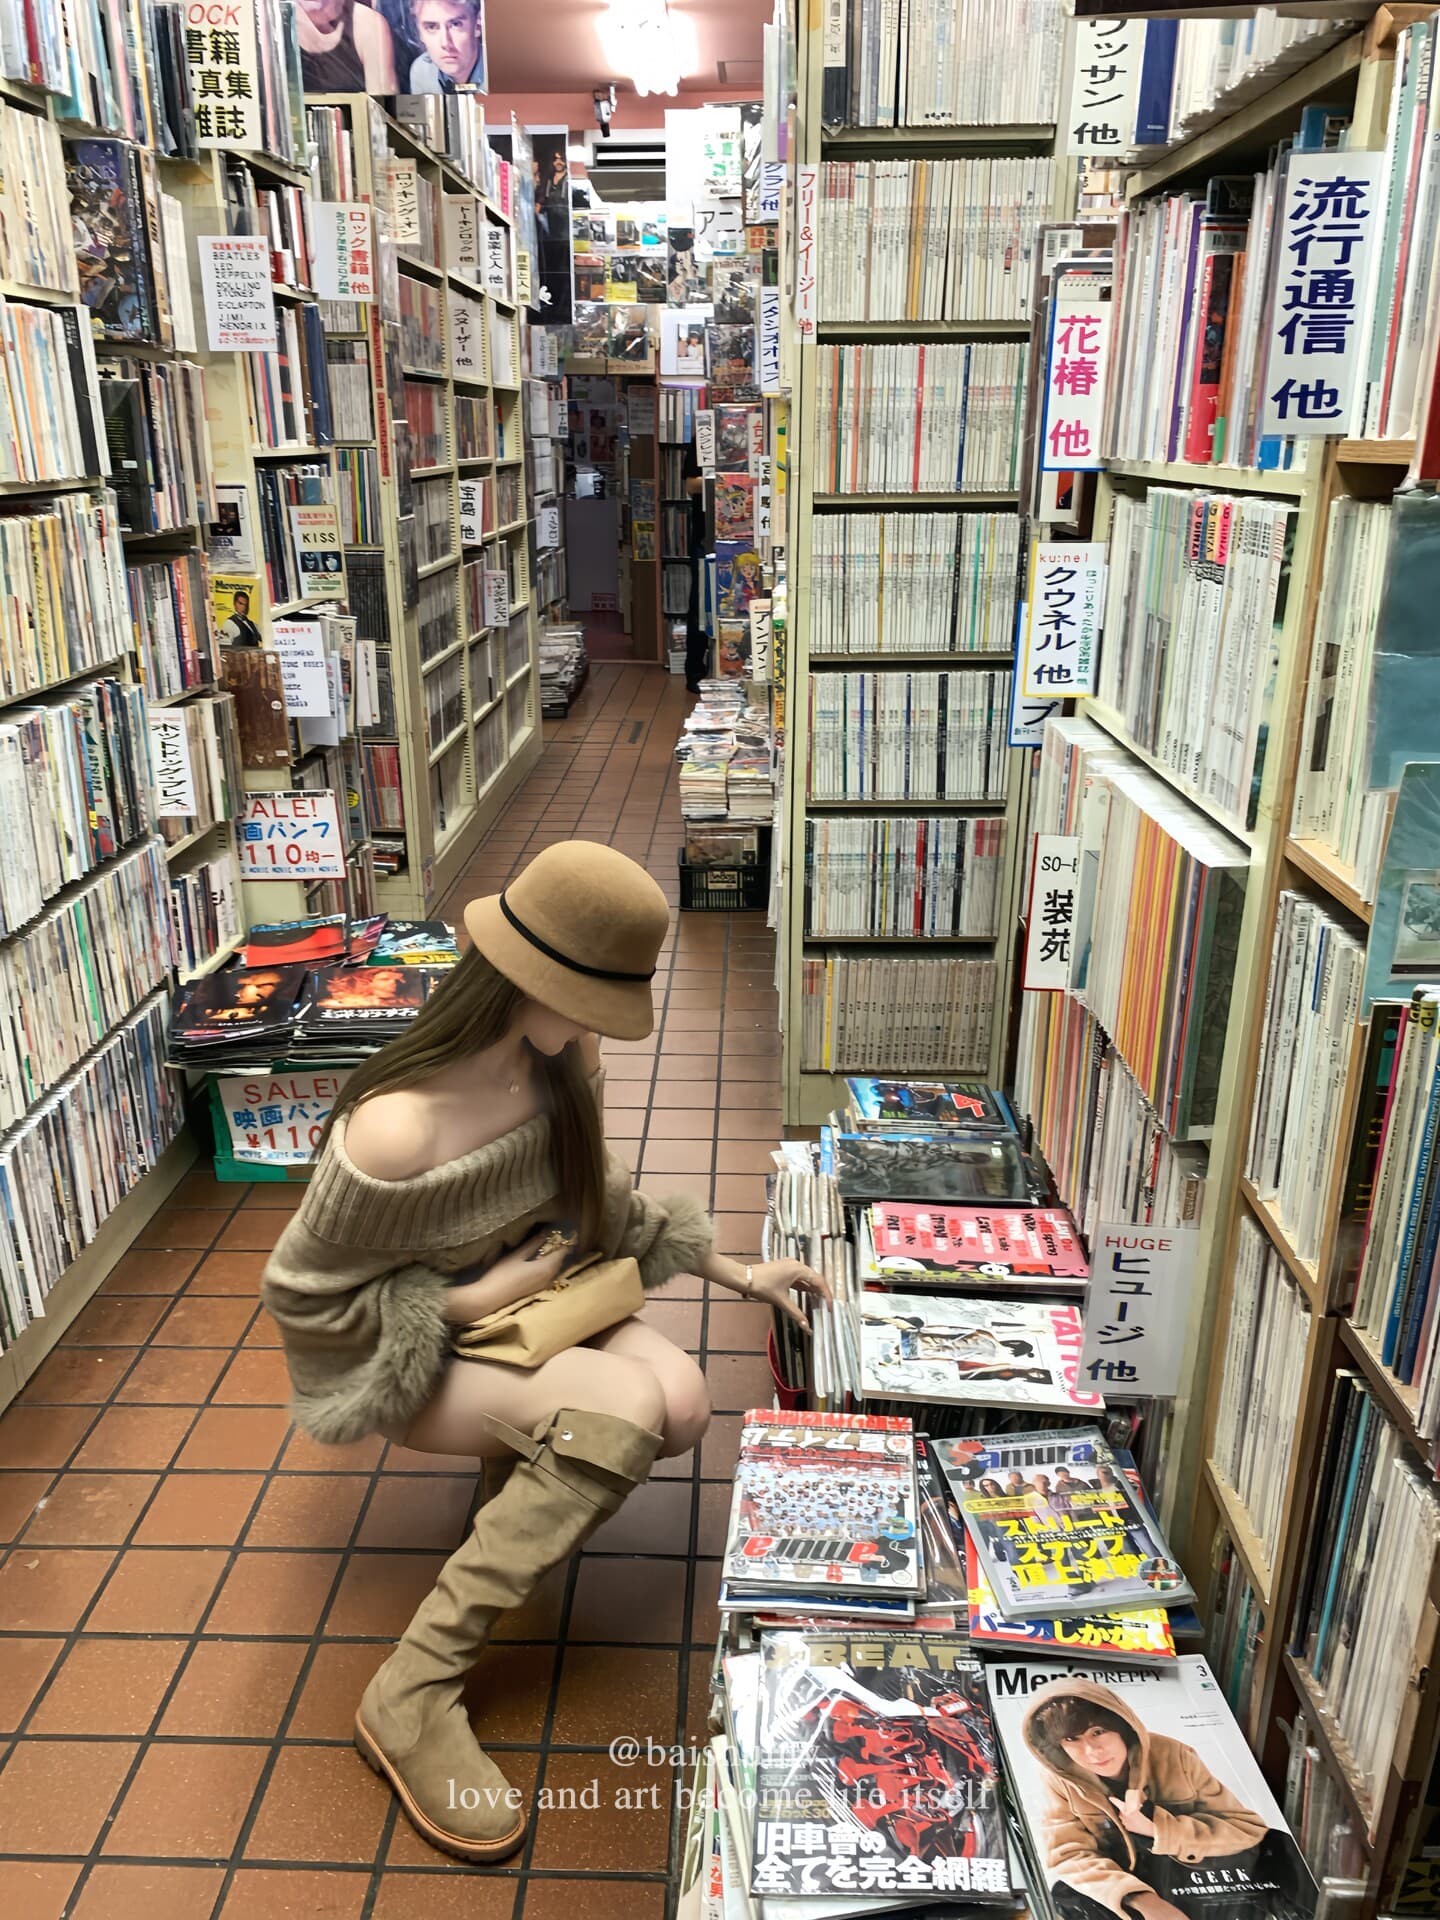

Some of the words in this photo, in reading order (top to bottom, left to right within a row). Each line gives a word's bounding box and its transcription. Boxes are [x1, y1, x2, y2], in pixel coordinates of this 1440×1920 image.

[190, 69, 253, 100] 真集
[1072, 121, 1122, 146] 他
[696, 210, 742, 236] アニ
[798, 172, 816, 310] フリー&イージー
[212, 251, 261, 260] BEATLES
[214, 262, 234, 271] LED
[1277, 175, 1371, 356] 流行通信
[218, 322, 268, 330] HENDRIX
[1052, 314, 1103, 397] 花椿
[1270, 378, 1345, 421] 他
[1048, 418, 1093, 458] 他
[302, 532, 337, 544] KISS
[1039, 553, 1089, 564] ku:nel
[1035, 566, 1078, 651] クウネル
[1033, 663, 1075, 685] 他
[238, 821, 330, 842] 画パンフ
[238, 843, 336, 865] 110均一
[243, 1078, 339, 1105] SALE!
[1104, 1236, 1173, 1251] HUGE
[1097, 1251, 1153, 1345] ヒュージ
[1086, 1358, 1140, 1382] 他
[946, 1439, 1100, 1482] Samura
[996, 1511, 1125, 1537] ストリート
[1092, 1669, 1165, 1685] PREPPY
[1196, 1665, 1208, 1677] 3
[752, 1855, 1010, 1893] 全てを完全網羅
[1190, 1868, 1251, 1885] GEEK
